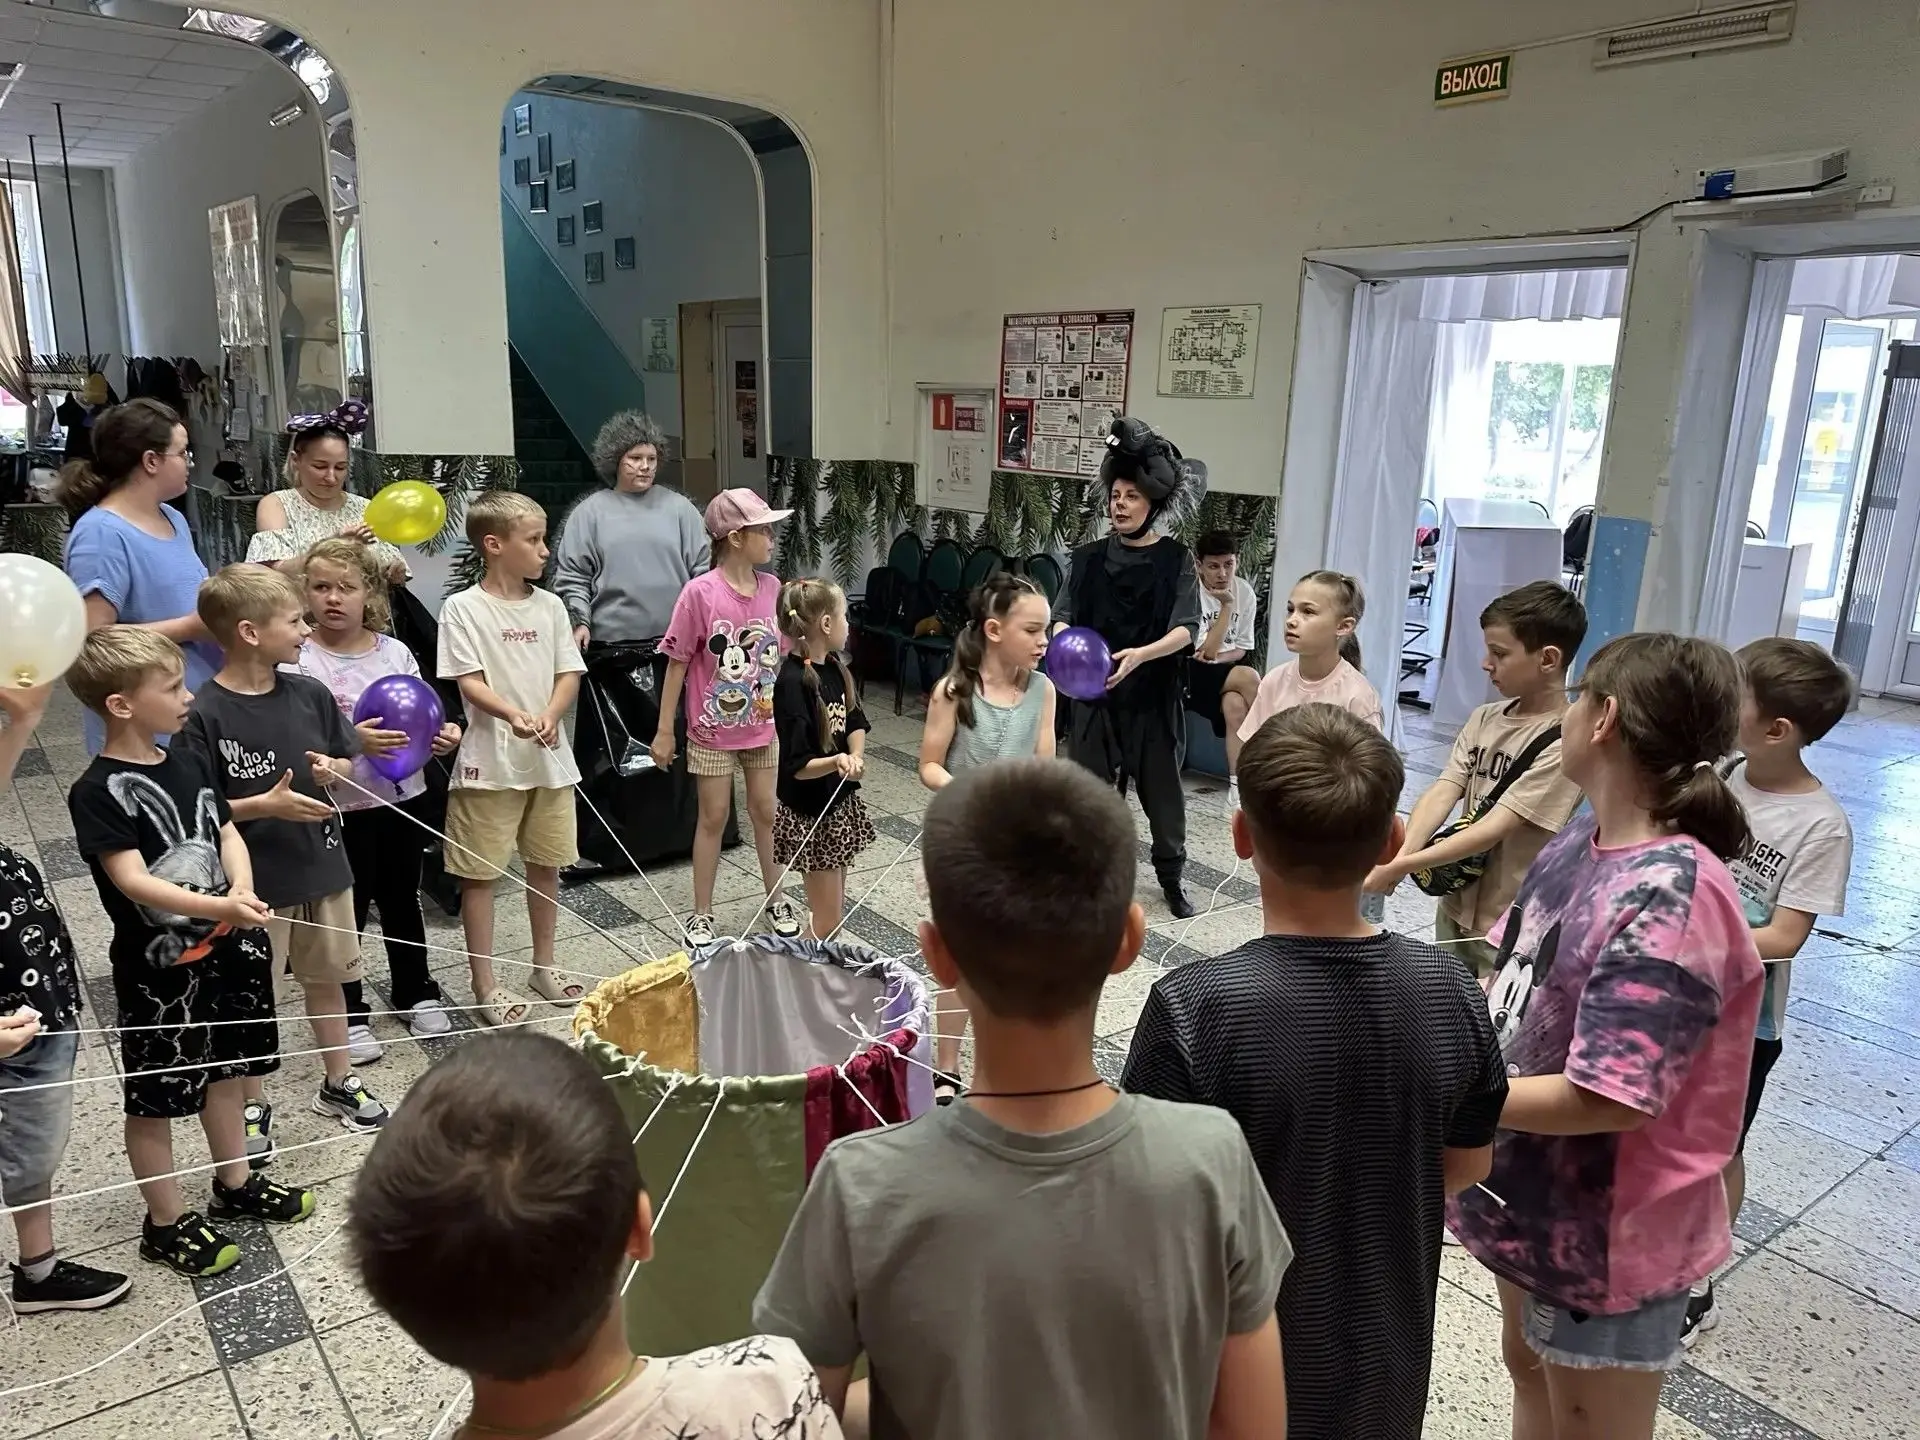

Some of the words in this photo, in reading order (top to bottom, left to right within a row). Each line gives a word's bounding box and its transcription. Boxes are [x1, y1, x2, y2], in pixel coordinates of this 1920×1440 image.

[1440, 61, 1502, 95] ВЫХОД
[218, 739, 261, 767] Who
[1752, 840, 1787, 868] IGHT
[1740, 856, 1777, 882] MMER
